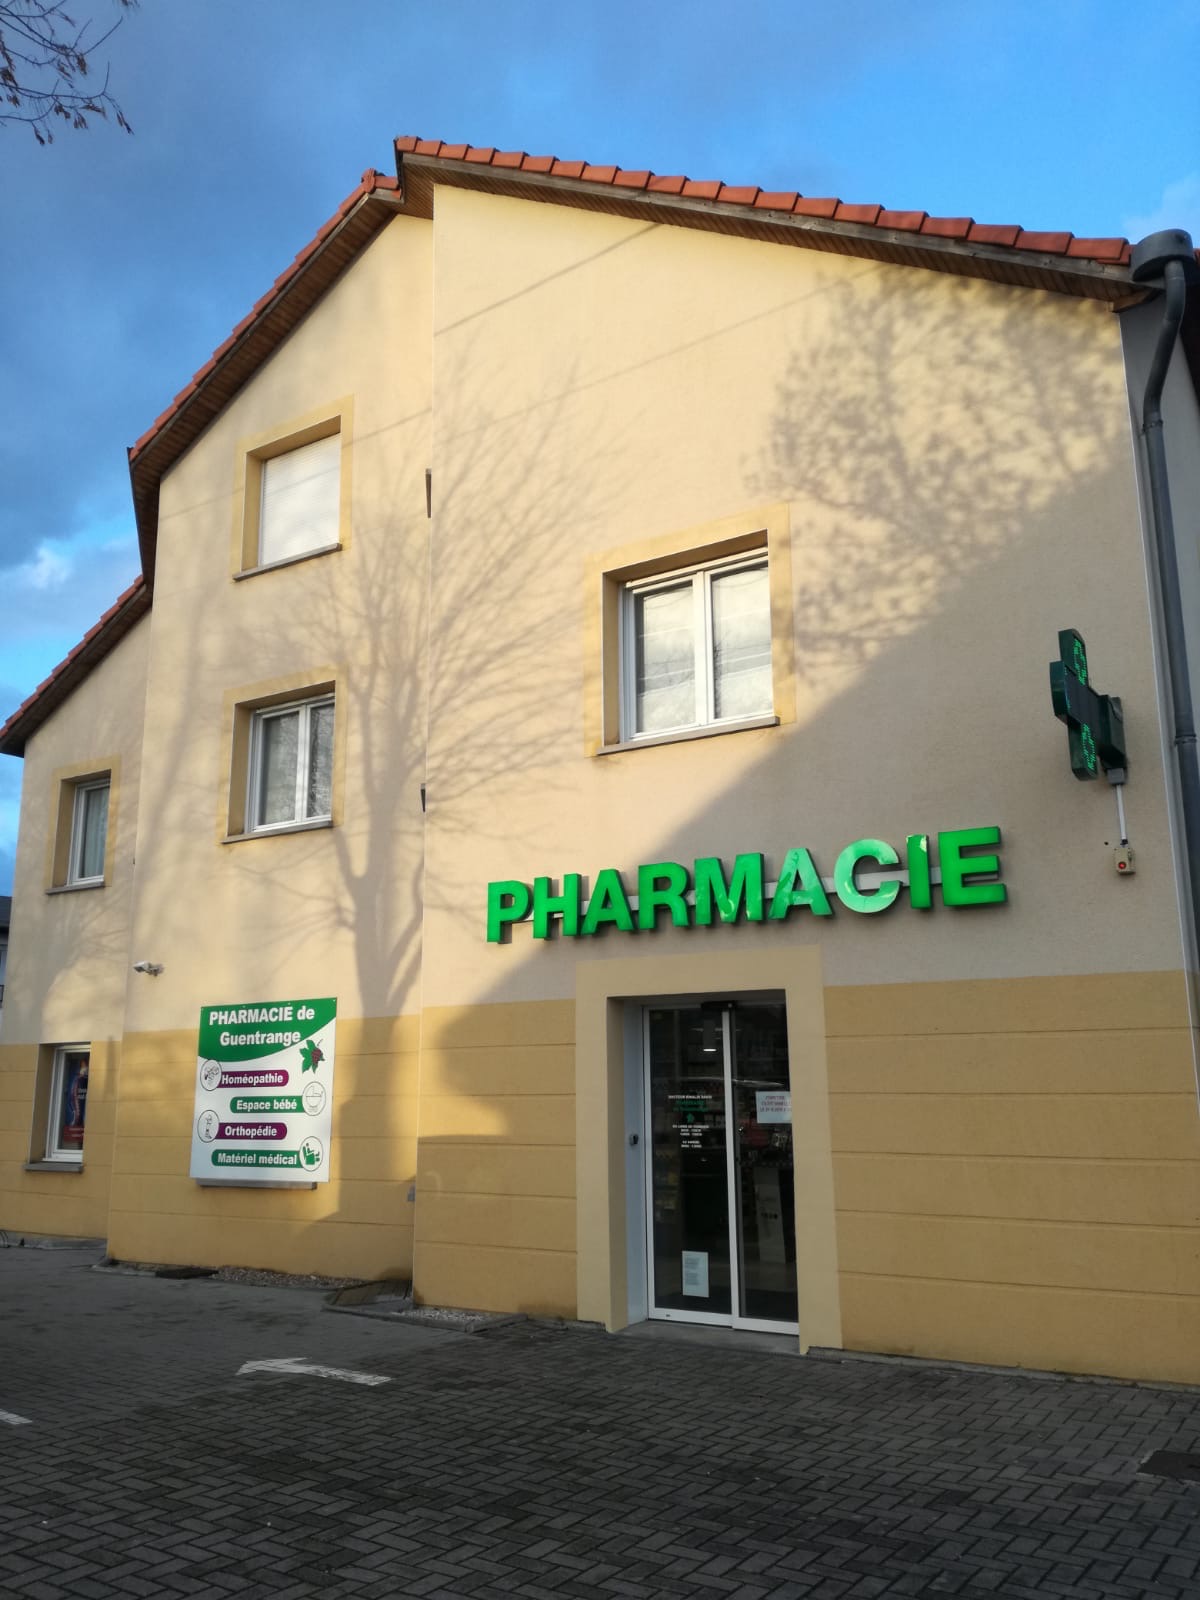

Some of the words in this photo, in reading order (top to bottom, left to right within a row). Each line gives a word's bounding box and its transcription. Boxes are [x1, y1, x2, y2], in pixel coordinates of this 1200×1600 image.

[486, 826, 1008, 943] PHARMACIE
[209, 1006, 293, 1025] PHARMACIE
[296, 1005, 315, 1020] de
[220, 1031, 301, 1046] Guentrange
[221, 1071, 284, 1086] Homéopathie
[236, 1099, 271, 1111] Espace
[273, 1097, 297, 1110] bébé
[225, 1125, 278, 1138] Orthopédie
[217, 1152, 256, 1164] Matériel
[259, 1153, 297, 1165] médical
